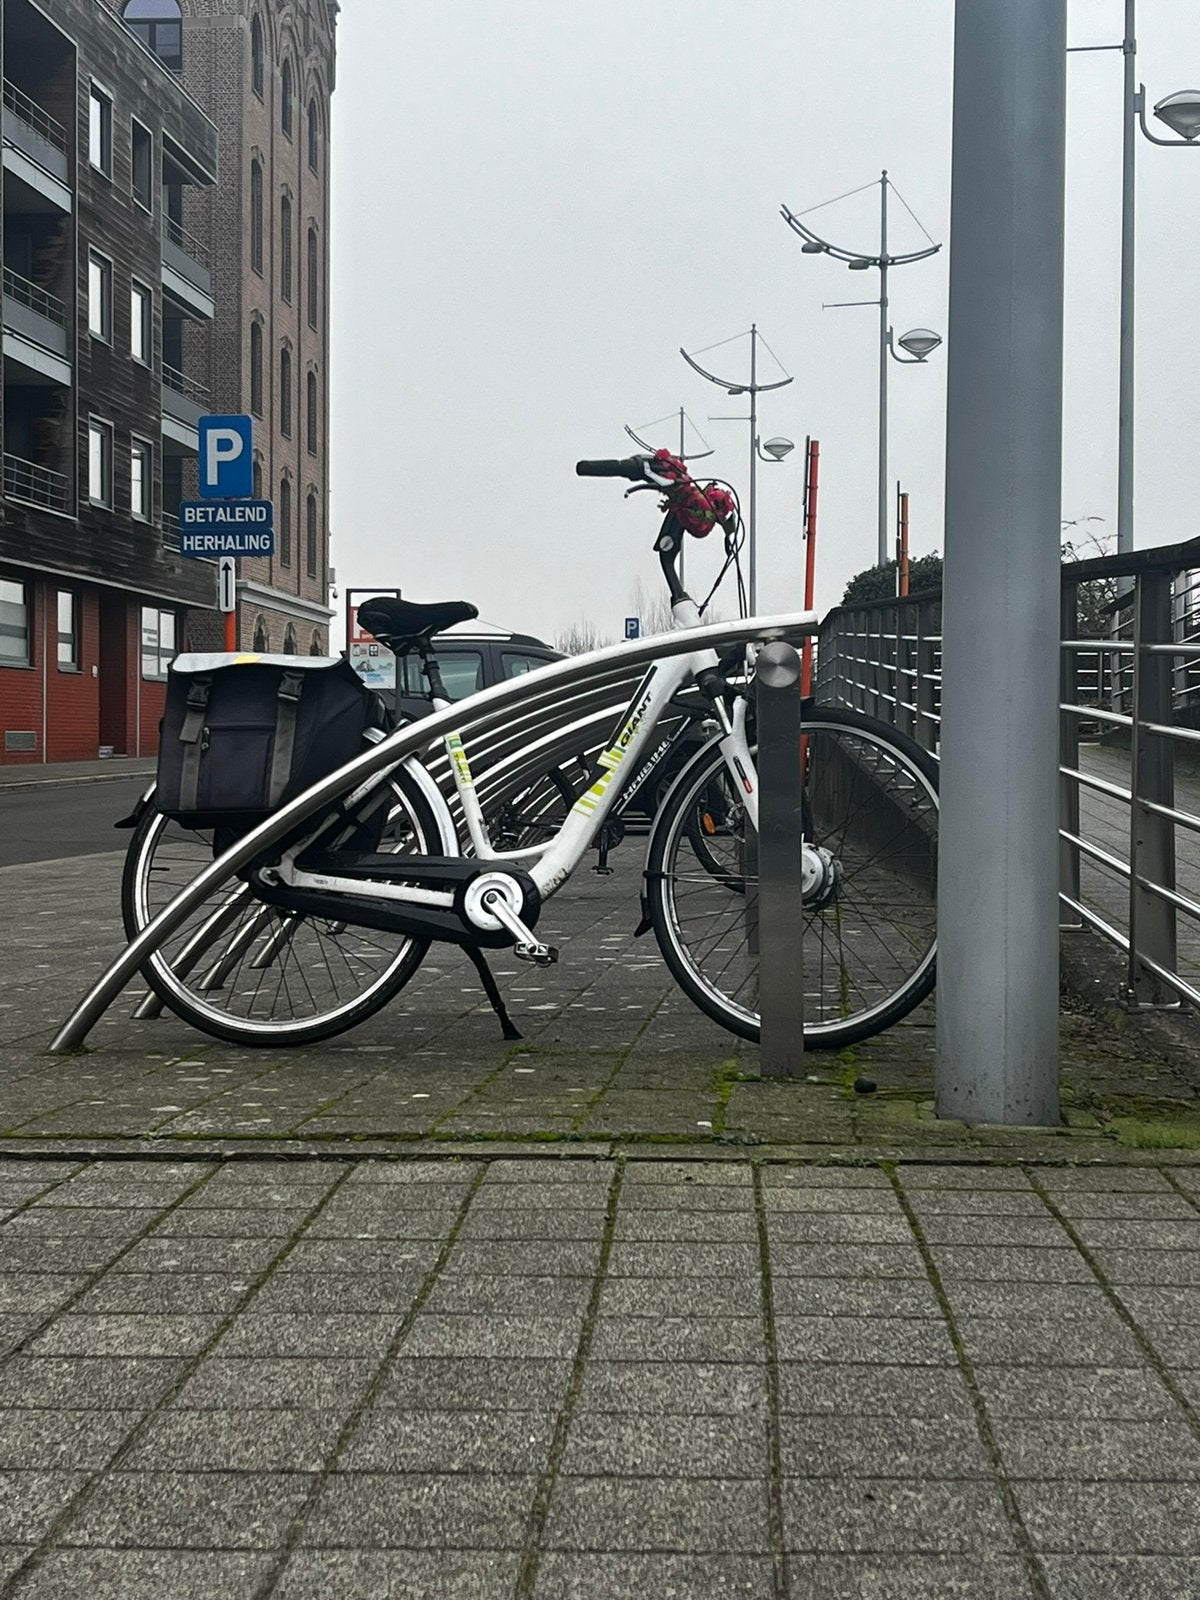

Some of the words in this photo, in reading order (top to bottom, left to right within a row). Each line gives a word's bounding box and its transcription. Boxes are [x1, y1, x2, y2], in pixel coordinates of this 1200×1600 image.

[206, 428, 243, 486] P
[184, 507, 267, 523] BETALEND
[183, 534, 270, 550] HERHALING
[627, 620, 637, 636] P
[620, 692, 652, 747] GIANT
